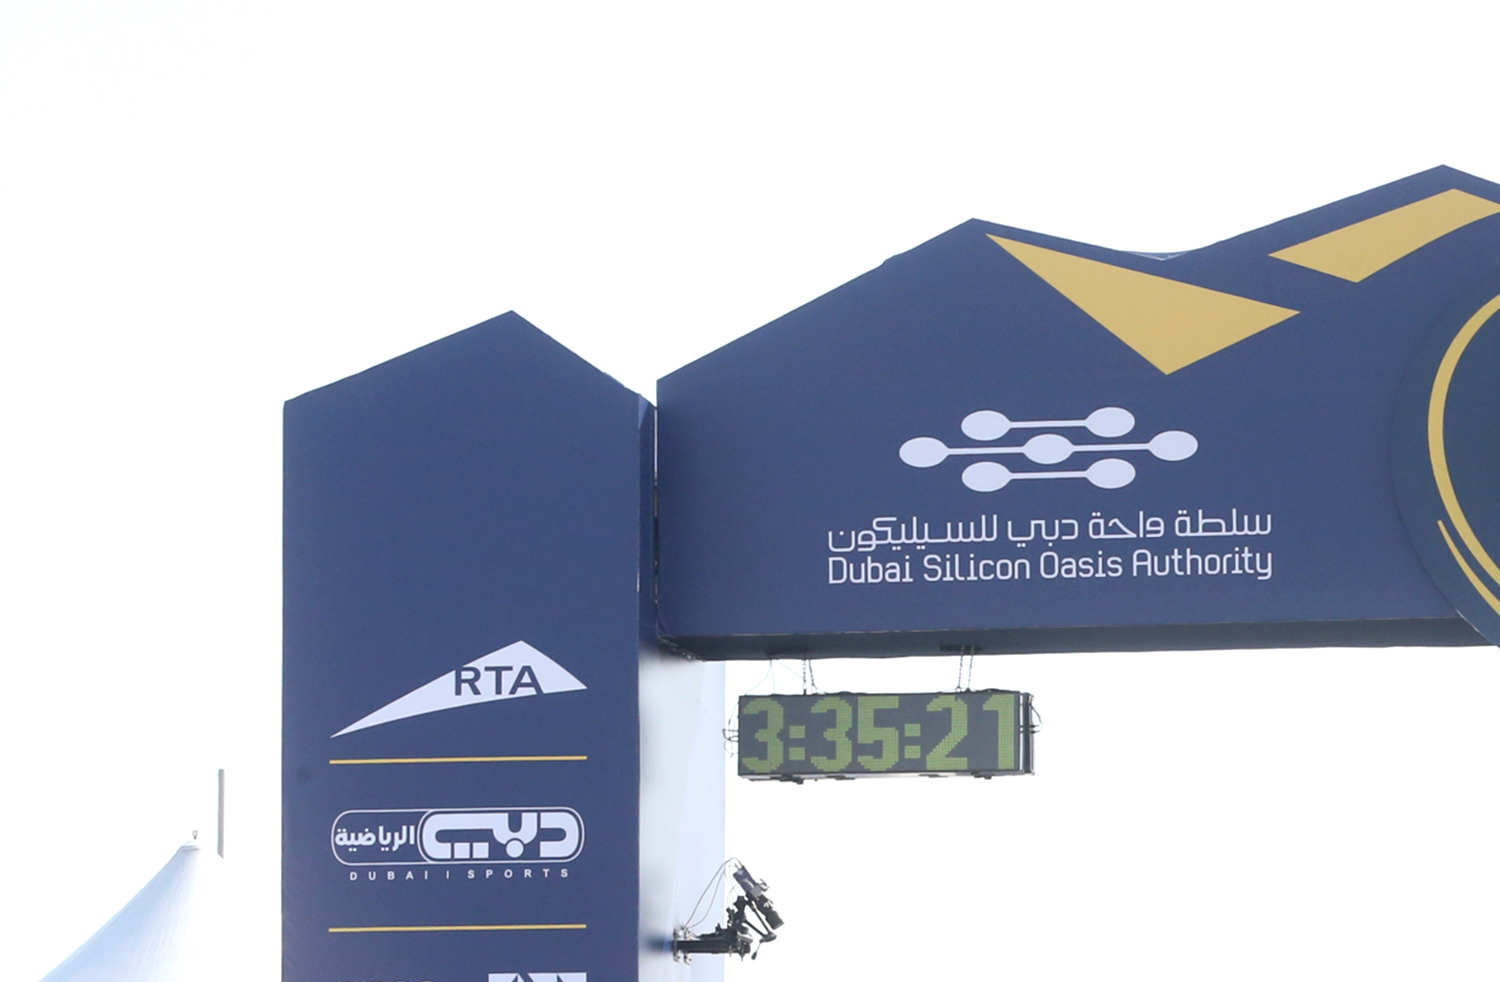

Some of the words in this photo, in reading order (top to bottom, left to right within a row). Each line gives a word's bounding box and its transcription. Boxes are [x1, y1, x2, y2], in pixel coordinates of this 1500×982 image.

[828, 514, 998, 552] للسيليكون
[1007, 518, 1079, 548] دبي
[1089, 511, 1165, 539] واحة
[1175, 509, 1272, 537] سلطة
[828, 553, 913, 584] Dubai
[923, 553, 1031, 582] Silicon
[1040, 550, 1122, 579] Oasis
[1132, 547, 1273, 580] Authority
[454, 665, 543, 697] RTA
[742, 694, 1015, 772] 3:35:21
[350, 871, 429, 881] DUBAI
[467, 869, 569, 879] SPORTS
